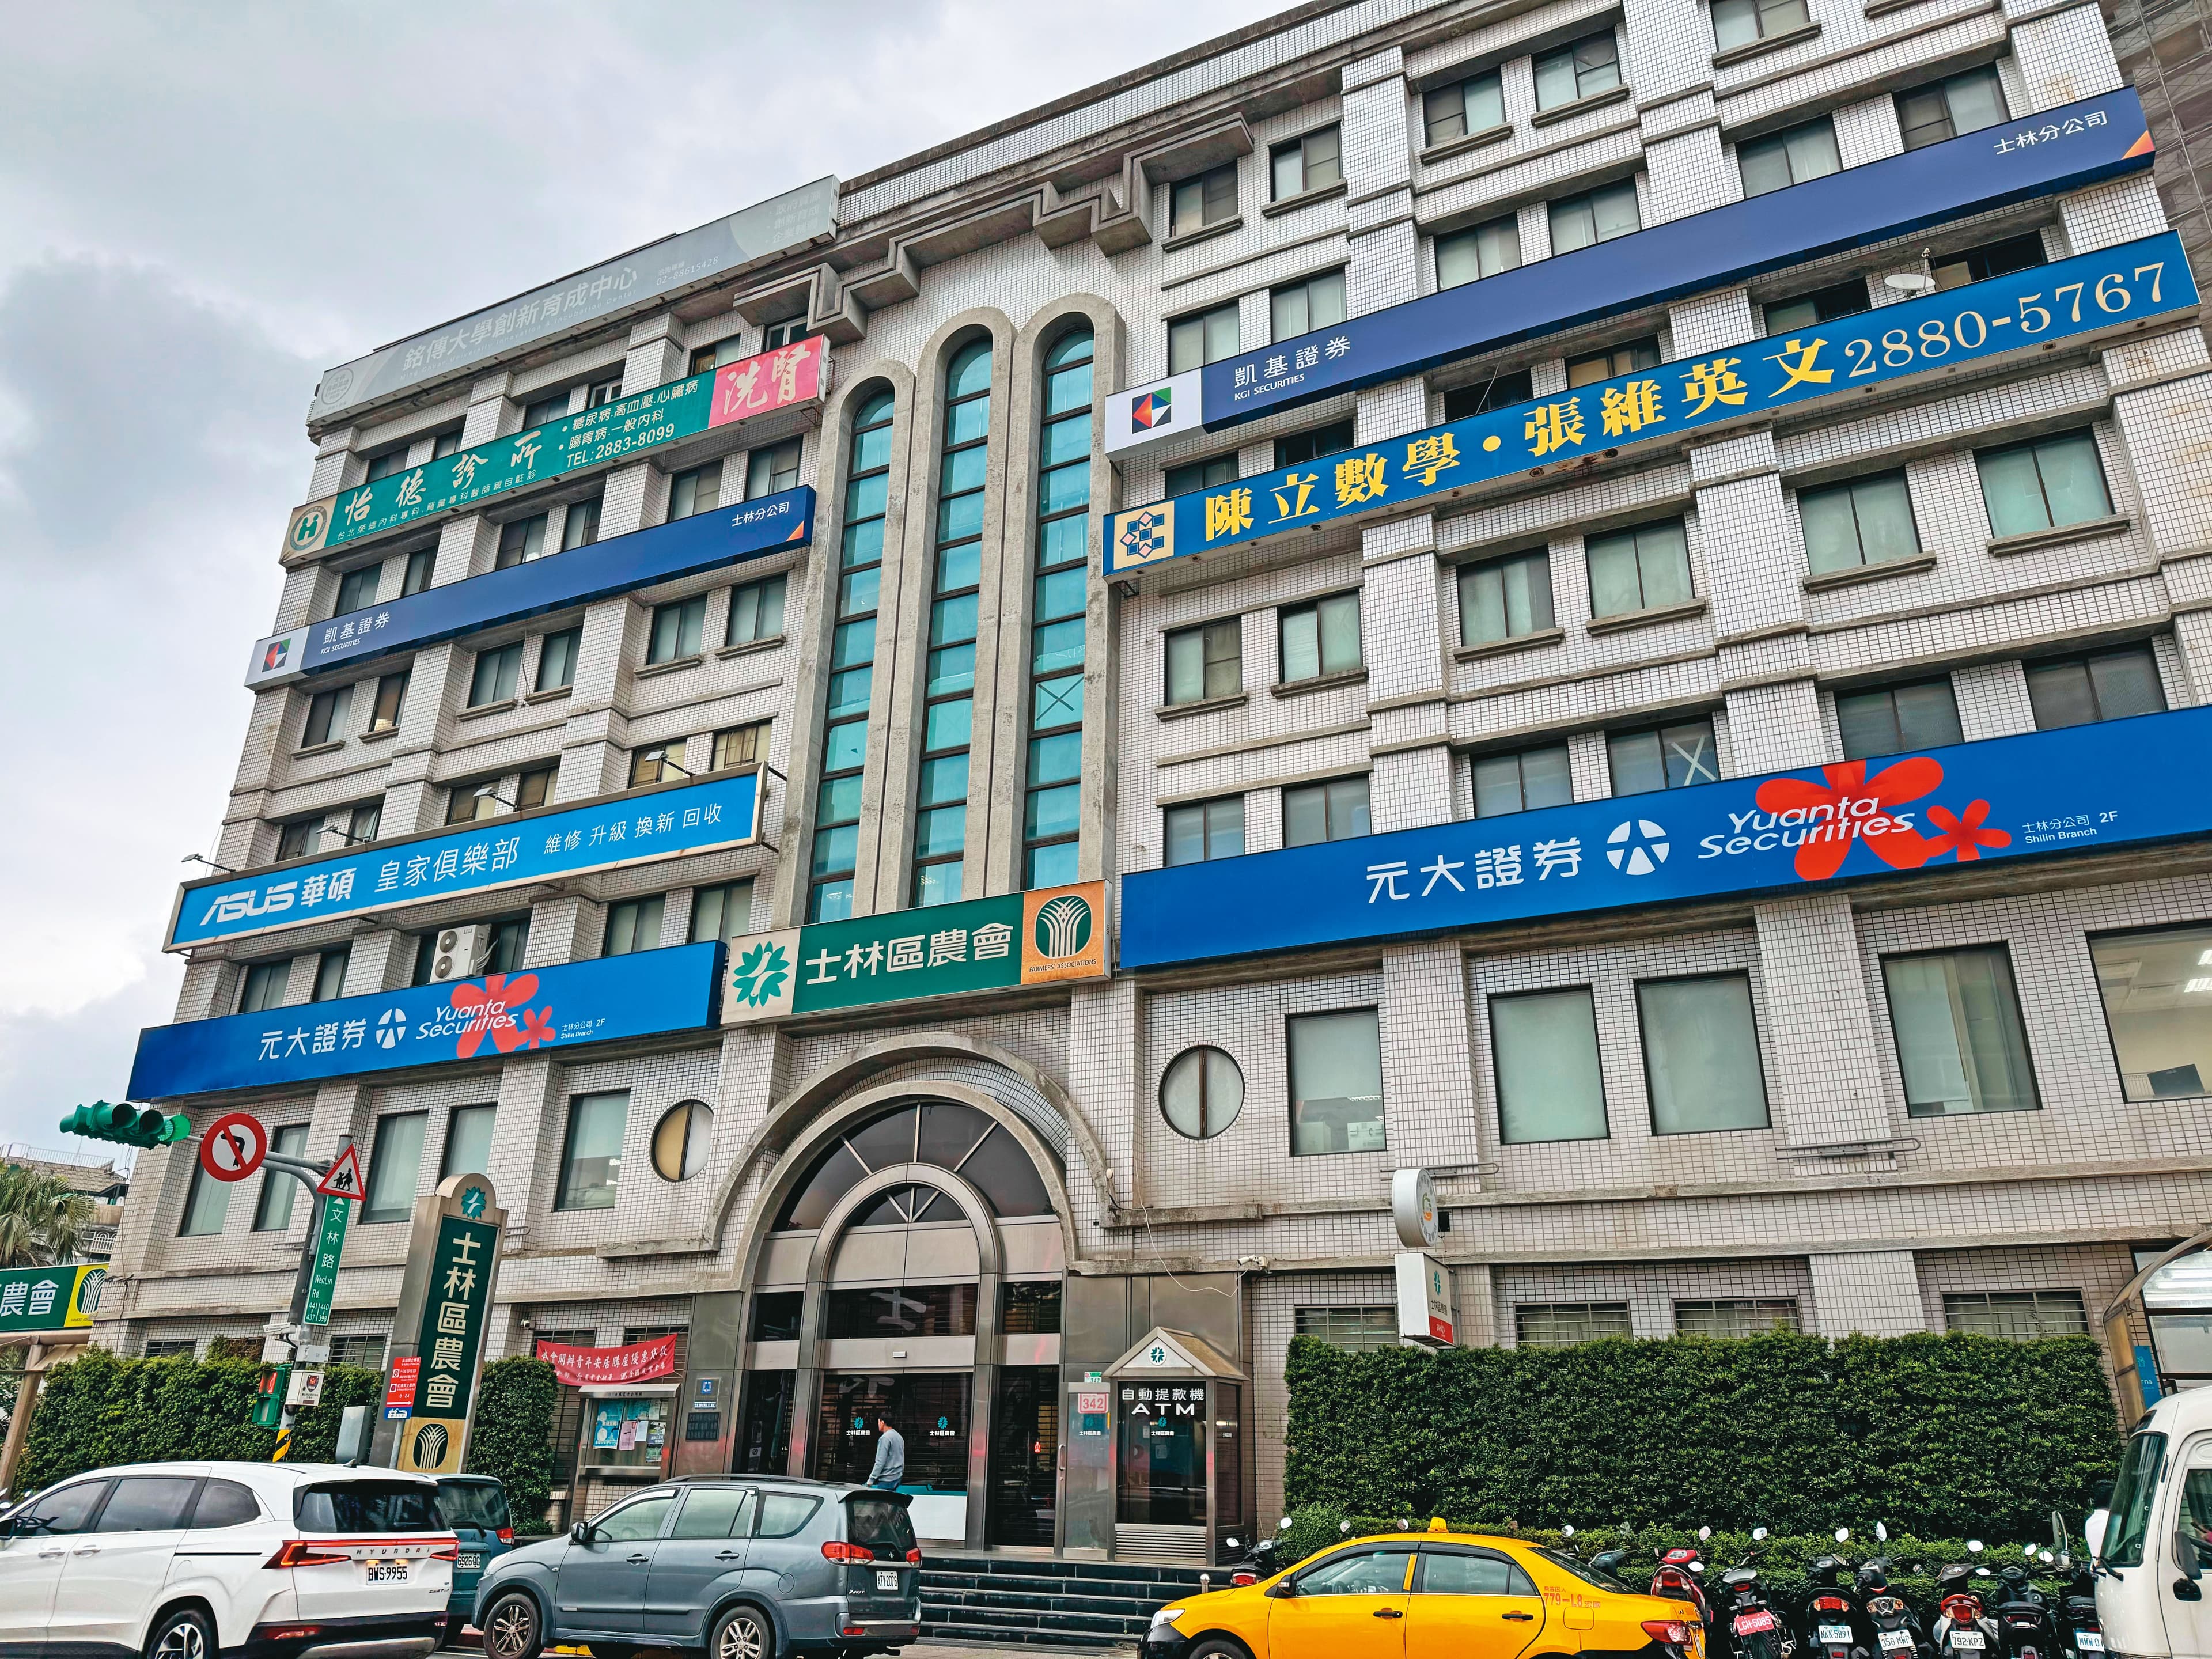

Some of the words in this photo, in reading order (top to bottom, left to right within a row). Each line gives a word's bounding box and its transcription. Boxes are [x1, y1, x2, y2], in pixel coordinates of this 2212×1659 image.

[1993, 111, 2107, 155] 士林分公司
[656, 257, 719, 286] 02-88615428
[402, 267, 638, 371] 銘傳大學創新育成中心
[1844, 261, 2165, 378] 2880-5767
[1234, 336, 1350, 388] 凱基證券
[724, 344, 811, 415] 洗腎
[1234, 391, 1251, 401] KGI
[1253, 373, 1305, 393] SECURITIES
[345, 430, 543, 527] 怡德診所
[732, 501, 789, 527] 士林分公司
[323, 611, 390, 645] 凱基證券
[320, 646, 330, 655] KGI
[331, 638, 361, 652] SECURITIES
[543, 830, 582, 855] 維修
[588, 821, 627, 847] 升級
[634, 810, 675, 839] 換新
[682, 802, 722, 829] 回收
[1727, 797, 1880, 834] Yuanta
[2022, 815, 2090, 834] 士林分公司
[2099, 810, 2118, 823] 2F
[1698, 813, 1916, 859] Securities
[2025, 834, 2056, 844] Shilin
[2058, 827, 2097, 840] Branch
[199, 881, 297, 926] ASUS
[300, 867, 357, 907] 華碩
[374, 836, 520, 893] 皇家俱樂部
[1366, 837, 1582, 904] 元大證券
[806, 922, 1014, 985] 士林區農會
[1029, 963, 1055, 972] FARMERS'
[1057, 958, 1097, 969] ASSOCIATIONS
[435, 999, 506, 1022] Yuanta
[416, 1012, 518, 1040] Securities
[562, 1020, 593, 1032] 士林分公司
[596, 1018, 605, 1027] 2F
[575, 1029, 593, 1037] Branch
[258, 1018, 366, 1061] 元大證券
[321, 1207, 344, 1269] 文林路
[315, 1274, 332, 1285] WenLin
[306, 1313, 316, 1321] 437
[318, 1315, 327, 1323] 398
[426, 1232, 482, 1409] 士林區農會
[1083, 1397, 1104, 1410] 342
[1122, 1388, 1204, 1401] 自動提款機
[1131, 1403, 1195, 1416] ATM
[357, 1547, 430, 1555] HYUNDAI
[368, 1566, 408, 1581] BWS-9955
[1544, 1593, 1582, 1607] 779-L8
[1737, 1616, 1771, 1631] LGH-5085
[1820, 1630, 1850, 1639] NKK-5891
[1952, 1637, 1984, 1646] 792-KPZ
